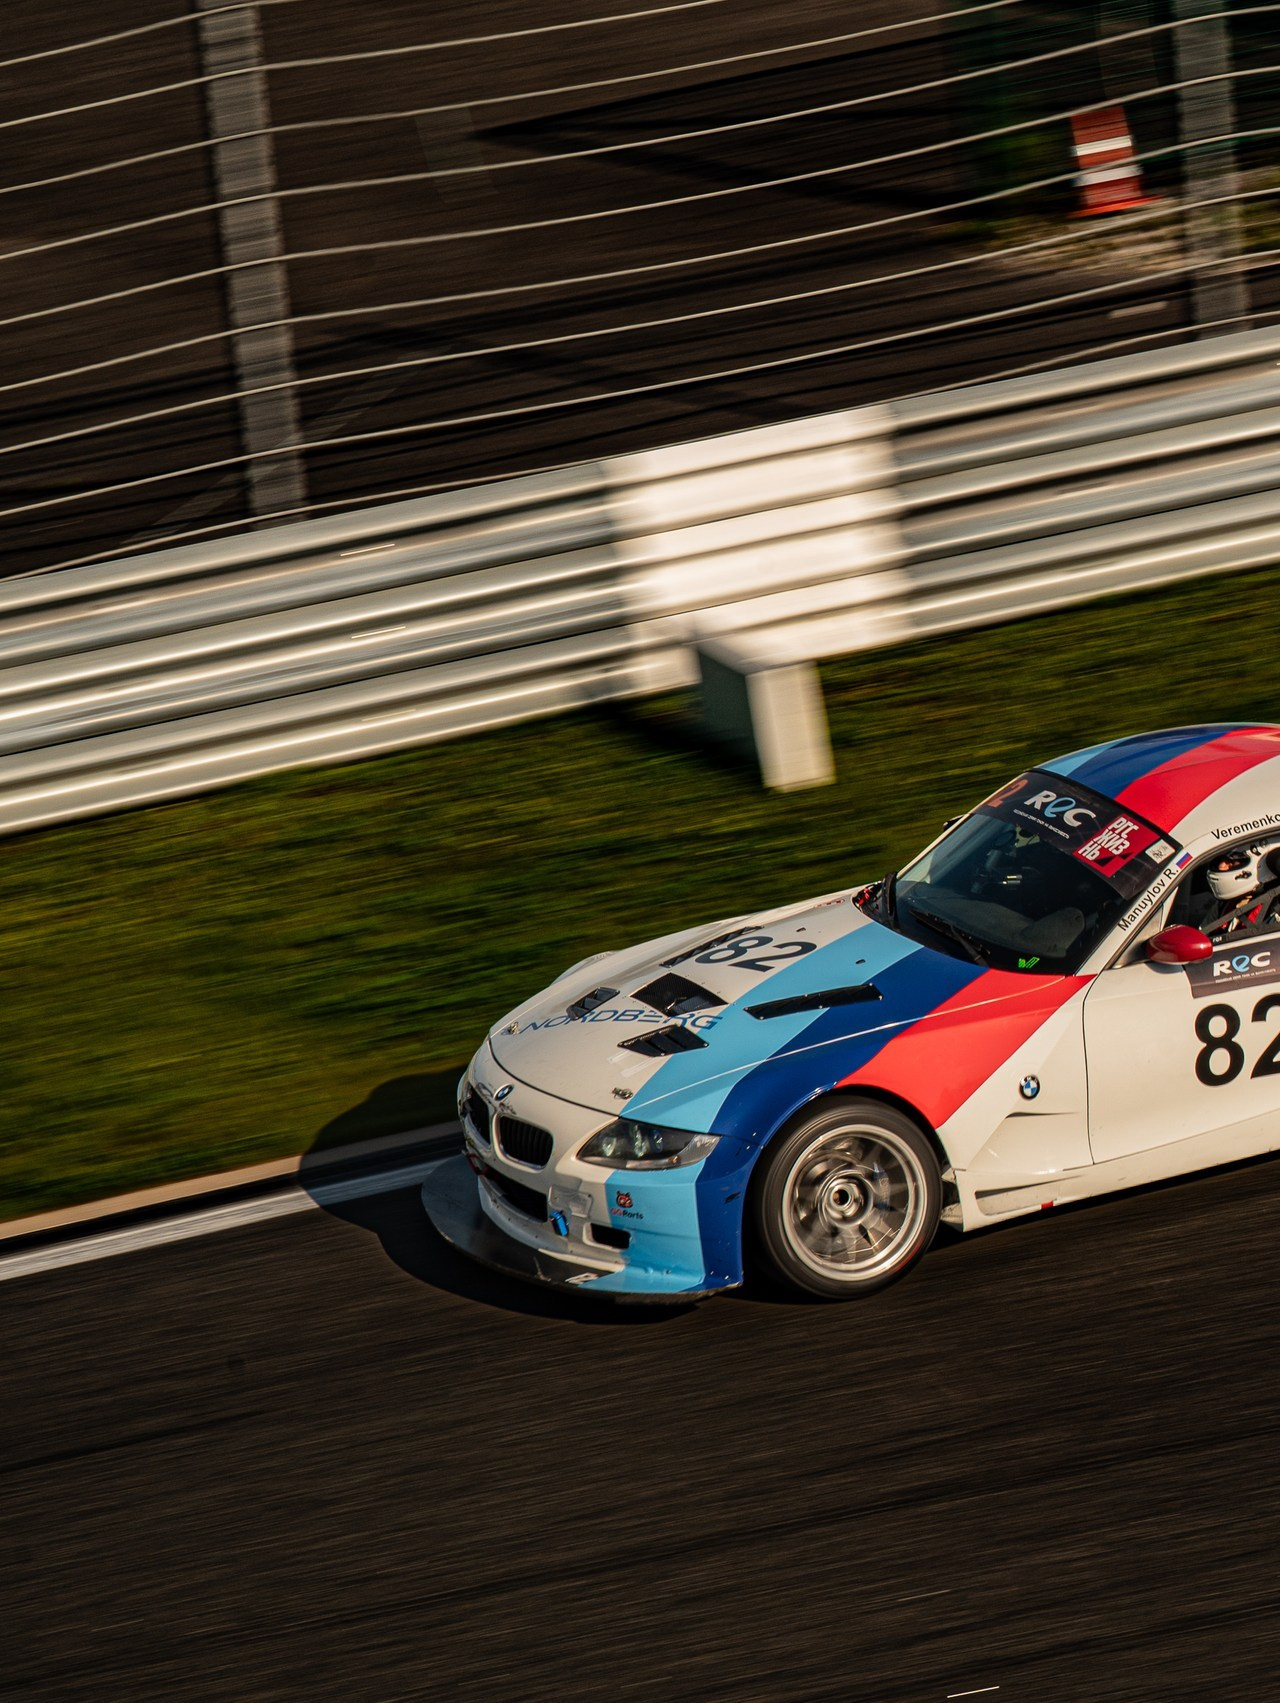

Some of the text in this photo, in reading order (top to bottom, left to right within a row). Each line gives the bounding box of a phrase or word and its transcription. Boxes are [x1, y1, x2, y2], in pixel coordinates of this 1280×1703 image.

[1093, 828, 1131, 856] ЖИЗ
[1108, 816, 1140, 839] РГС
[1117, 868, 1179, 932] Manuylov R.
[694, 935, 817, 973] 82
